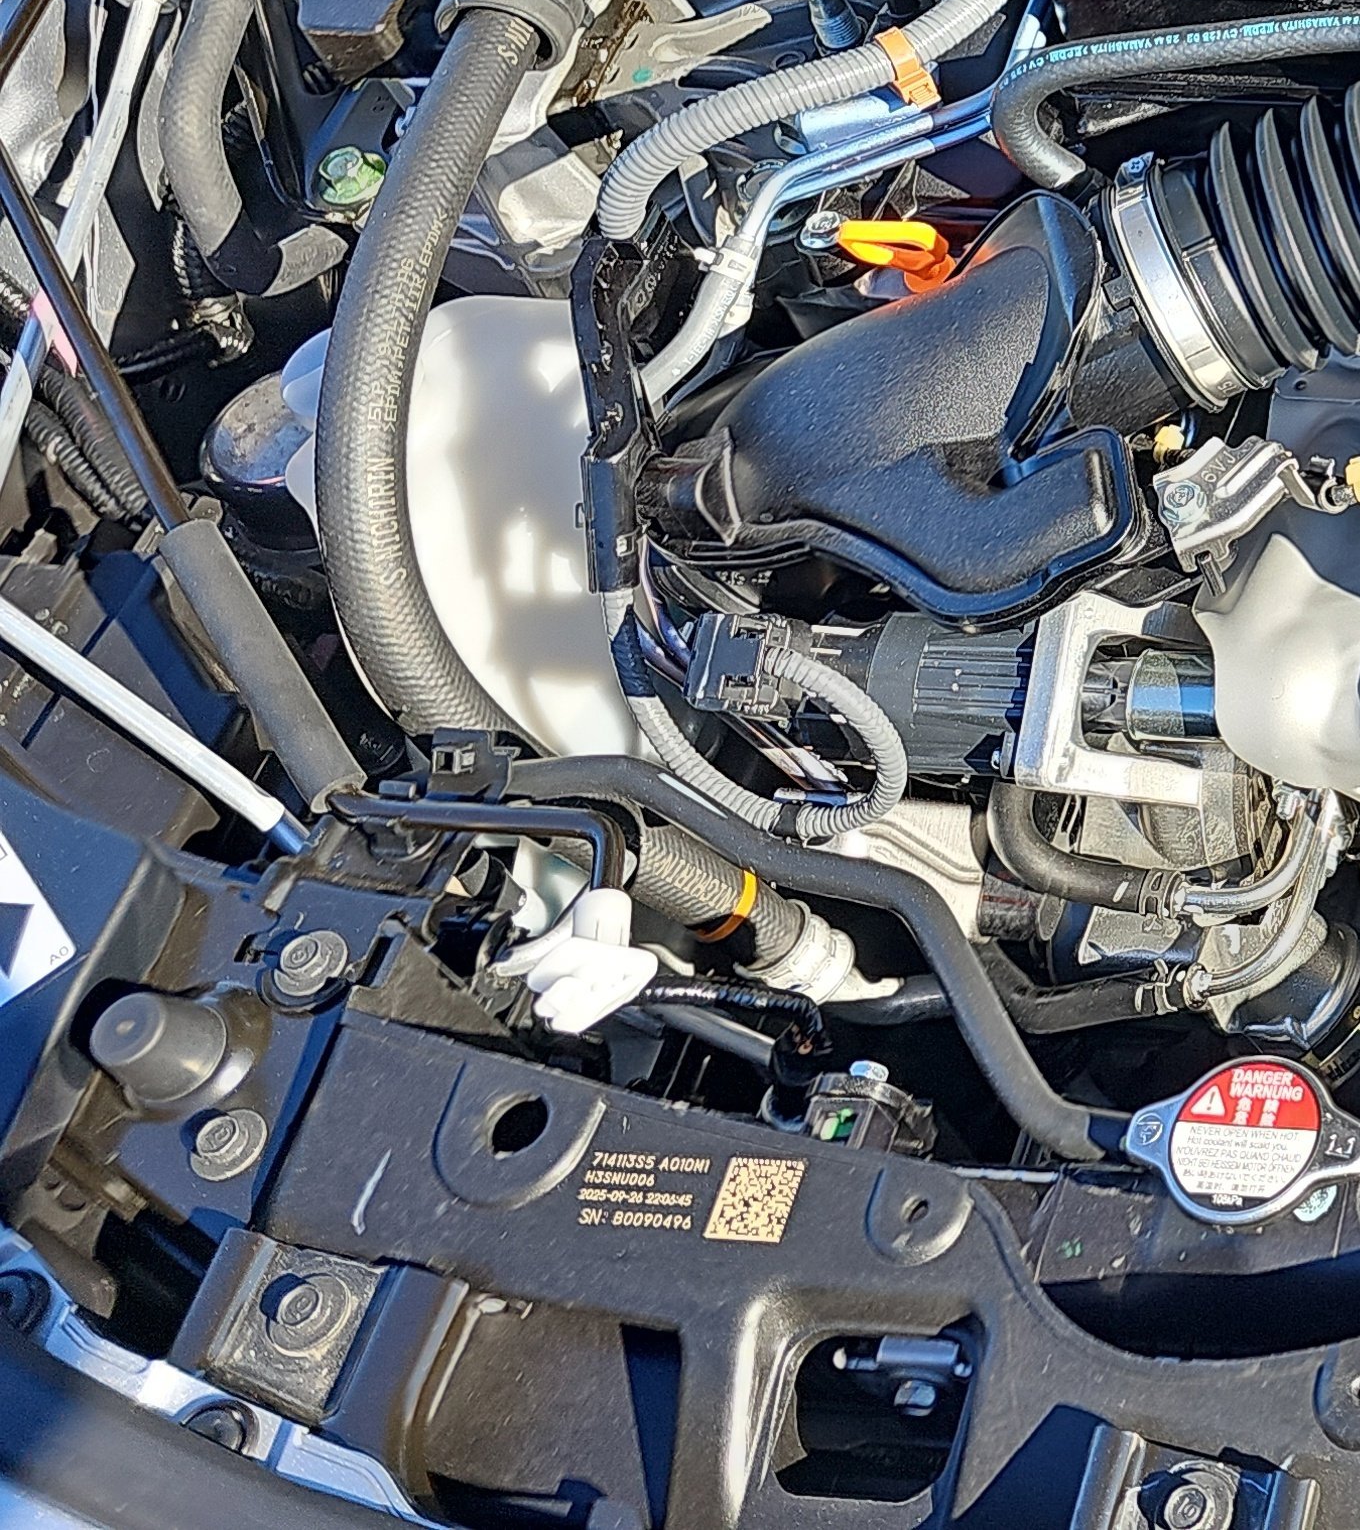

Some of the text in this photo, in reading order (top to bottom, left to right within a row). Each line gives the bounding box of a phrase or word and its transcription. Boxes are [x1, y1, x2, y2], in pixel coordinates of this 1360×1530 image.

[1281, 15, 1341, 32] YAMASHITA
[1090, 38, 1153, 54] YAMASHITA
[1231, 1068, 1294, 1086] DANGER
[1229, 1083, 1304, 1101] WARNUNG
[1189, 1126, 1221, 1137] NEVER
[1224, 1128, 1247, 1138] OPEN
[1249, 1130, 1277, 1140] WHEN
[1220, 1148, 1240, 1159] PAS
[658, 1155, 711, 1174] A010M1
[577, 1187, 694, 1207] 2025-09-26 22:06:45
[611, 1211, 692, 1231] B0090496
